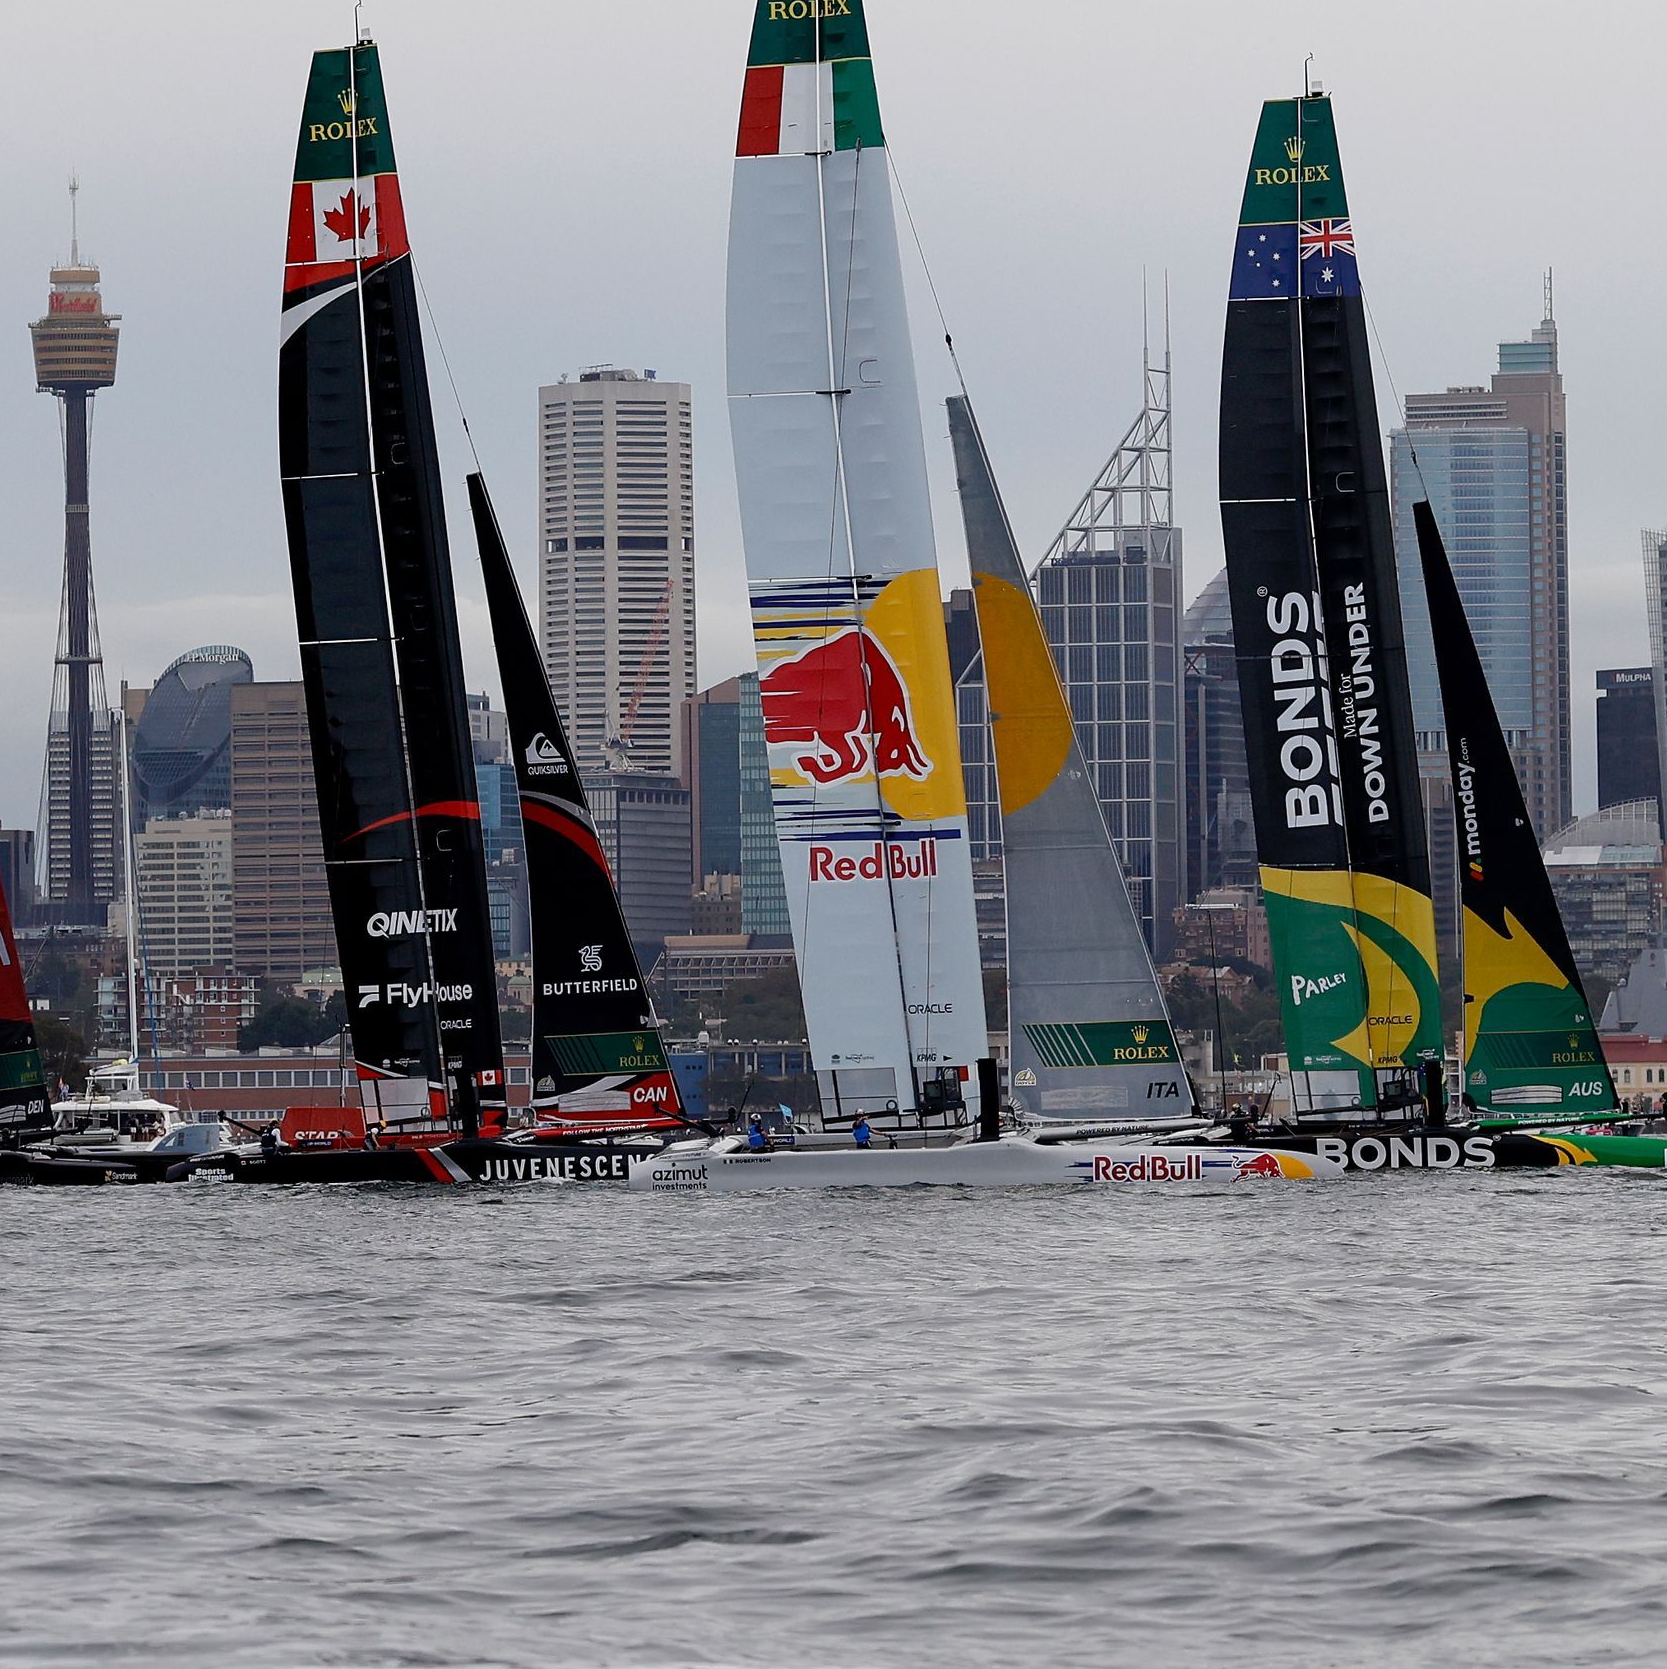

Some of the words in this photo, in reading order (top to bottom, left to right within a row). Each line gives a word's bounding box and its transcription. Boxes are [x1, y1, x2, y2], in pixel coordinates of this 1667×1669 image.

[308, 117, 379, 143] ROLEX
[1254, 164, 1331, 185] ROLEX
[1344, 582, 1375, 700] UNDER
[1338, 673, 1352, 693] for
[1341, 695, 1357, 740] Made
[527, 764, 569, 776] QUIKSILVER
[1357, 708, 1389, 823] DOWN
[1457, 737, 1481, 856] monday.com
[810, 842, 884, 882] Red
[889, 838, 937, 880] Bull
[543, 978, 638, 996] BUTTERFIELD
[1291, 972, 1347, 1006] PARLEY
[908, 1003, 953, 1014] ORACLE
[440, 1019, 472, 1030] ORACLE
[1369, 1015, 1413, 1026] ORACLE
[619, 1055, 661, 1067] ROLEX
[916, 1054, 937, 1062] KPMG
[1113, 1046, 1170, 1060] ROLEX
[1378, 1055, 1398, 1064] KPMG
[1552, 1051, 1596, 1063] ROLEX
[633, 1086, 667, 1103] CAN
[1146, 1082, 1180, 1099] ITA
[1568, 1081, 1603, 1097] AUS
[27, 1099, 44, 1114] DEN
[1076, 1128, 1111, 1136] POWERED
[111, 1170, 138, 1180] Sandmark
[195, 1168, 226, 1178] Sports
[652, 1162, 709, 1181] azimut
[1094, 1155, 1146, 1181] Red
[1151, 1154, 1201, 1181] Bull
[652, 1181, 707, 1191] investments
